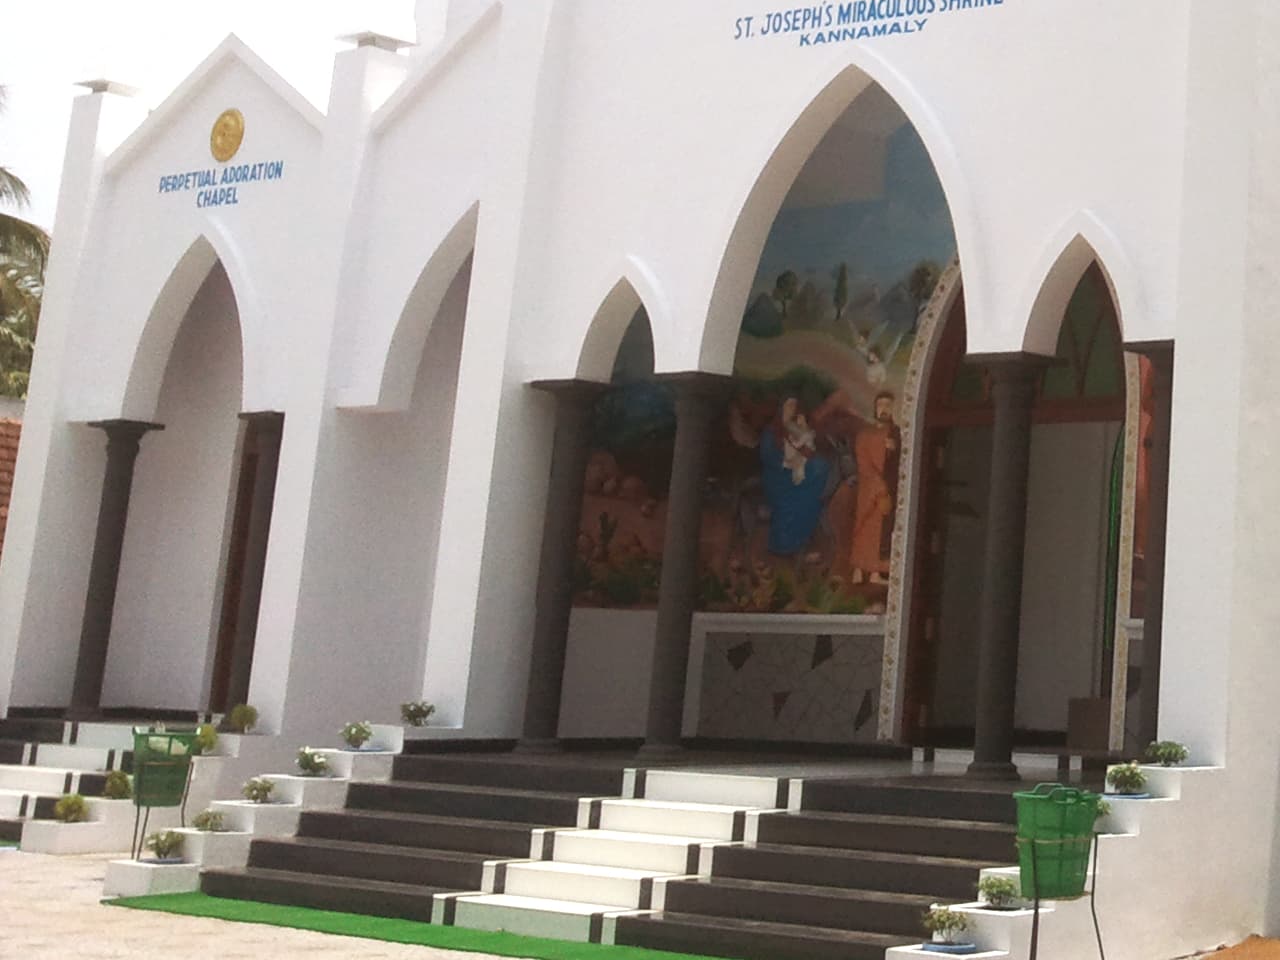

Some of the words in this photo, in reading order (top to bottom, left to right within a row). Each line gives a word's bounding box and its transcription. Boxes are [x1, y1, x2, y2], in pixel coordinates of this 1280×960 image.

[760, 0, 834, 36] JOSEPH'S
[799, 18, 929, 47] KANNAMALY
[158, 168, 218, 194] PERPETUAL
[220, 160, 284, 185] ADORATION
[196, 186, 239, 208] CHAPEL
